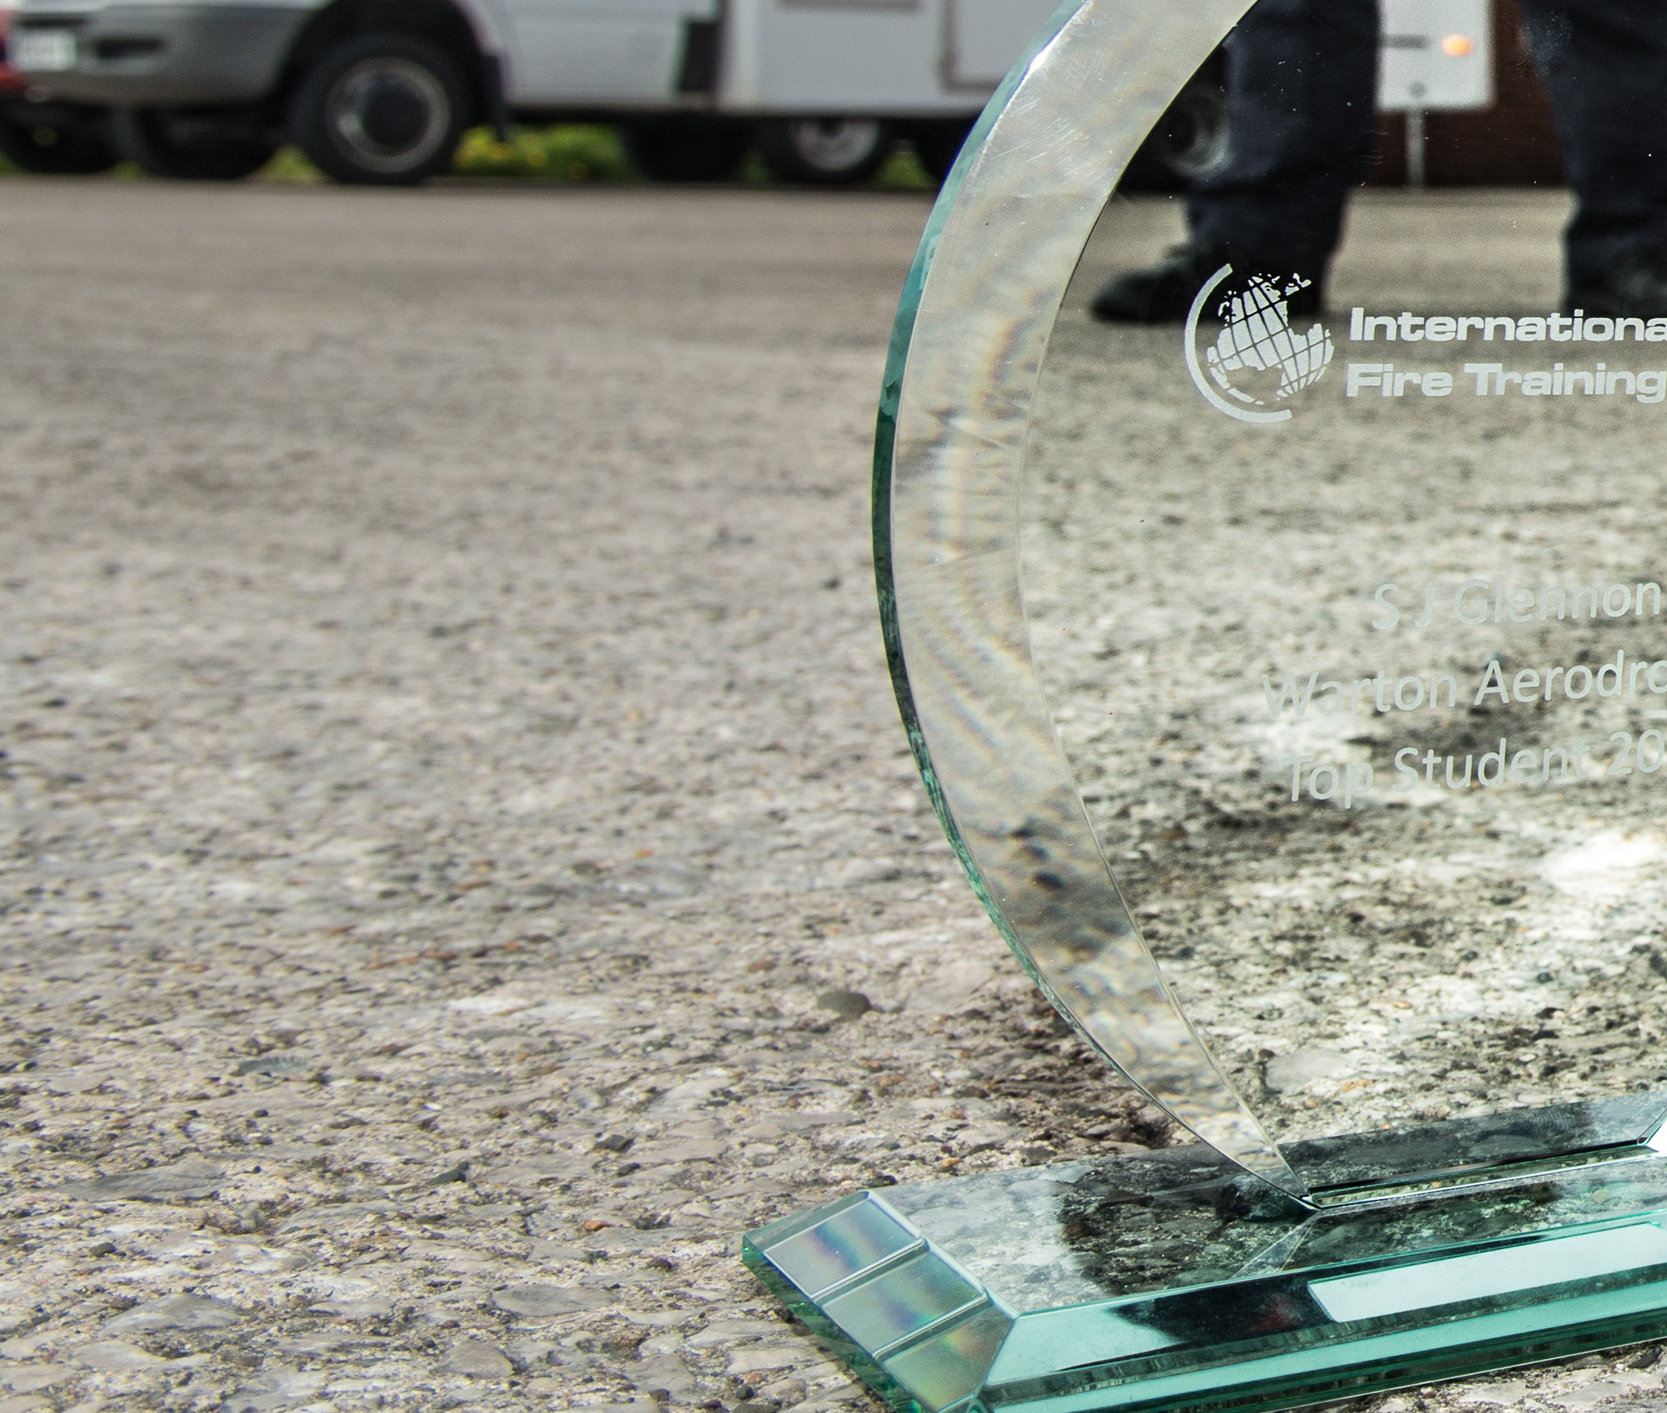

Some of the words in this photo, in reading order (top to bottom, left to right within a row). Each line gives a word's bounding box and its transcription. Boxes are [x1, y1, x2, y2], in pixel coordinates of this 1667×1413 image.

[1347, 362, 1453, 397] Fire
[1465, 362, 1667, 403] Training
[1372, 583, 1400, 629] S
[1415, 582, 1433, 628] J
[1453, 575, 1662, 625] Glennon
[1261, 670, 1457, 718] Warton
[1283, 753, 1375, 809] Top
[1392, 738, 1591, 792] Student
